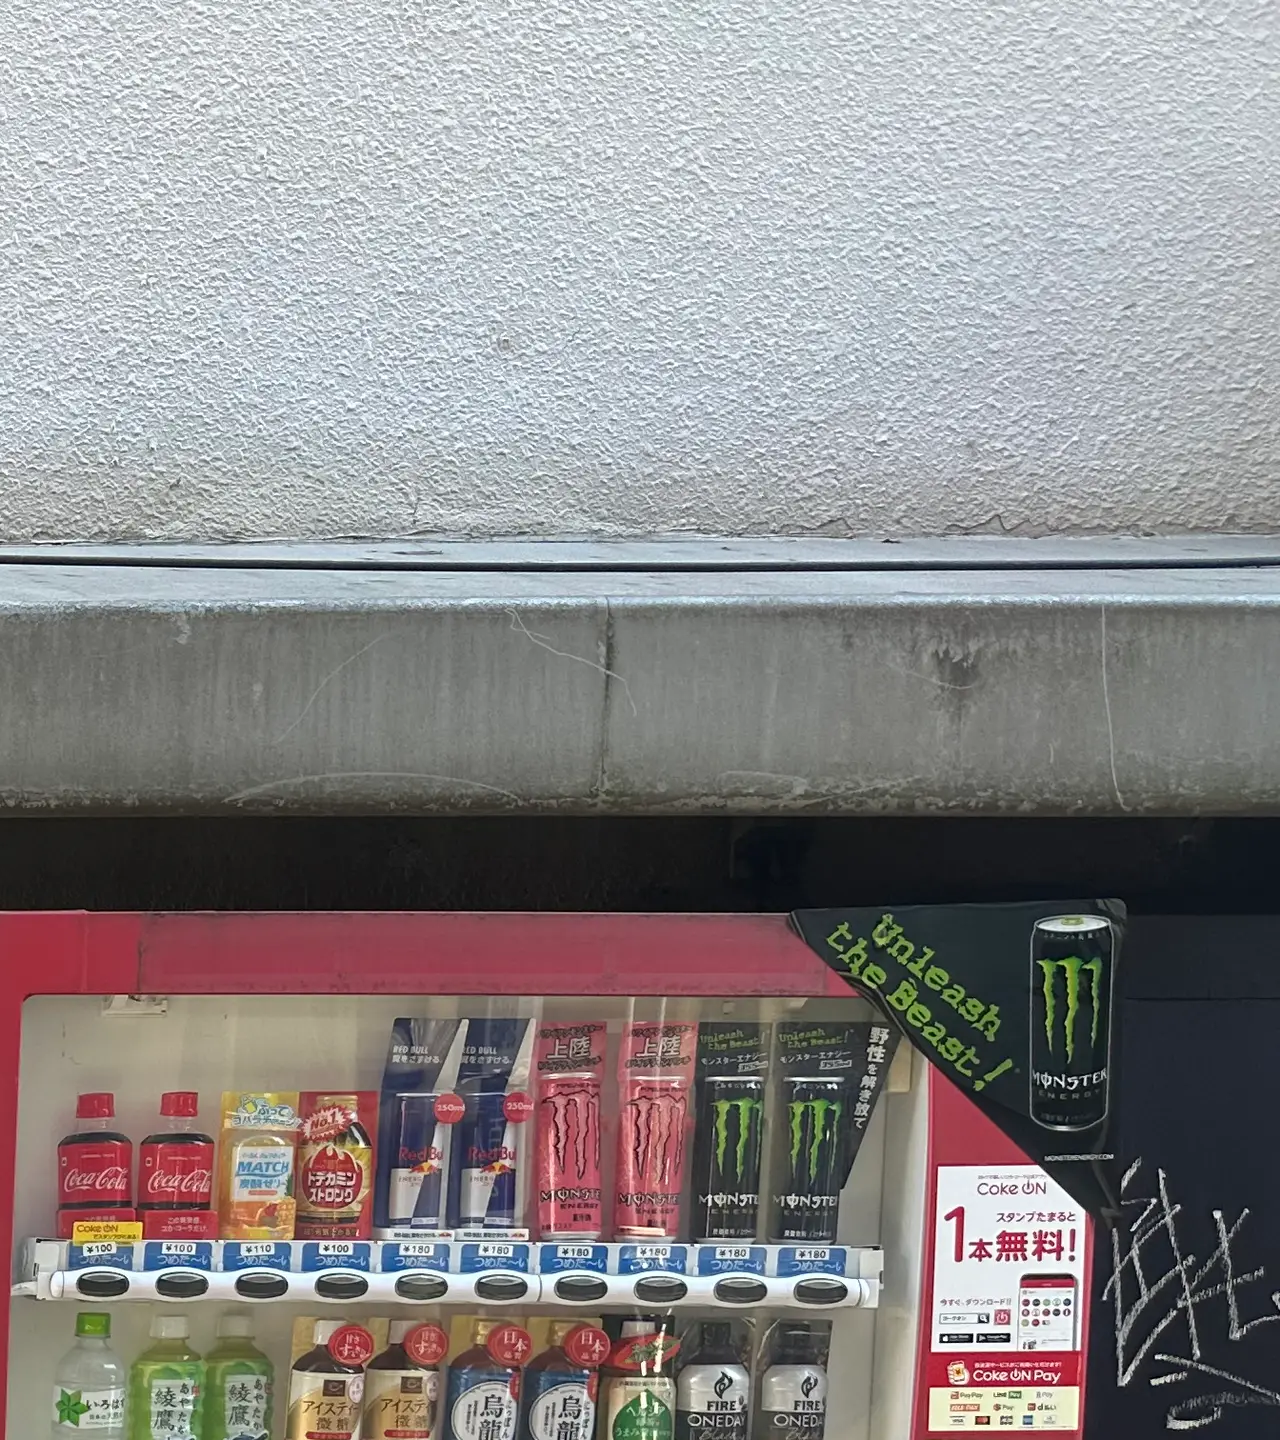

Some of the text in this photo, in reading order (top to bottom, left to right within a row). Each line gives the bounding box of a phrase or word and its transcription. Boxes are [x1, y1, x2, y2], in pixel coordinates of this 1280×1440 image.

[871, 913, 1002, 1042] Unleash
[826, 921, 1014, 1092] the Beast!
[410, 1046, 429, 1055] BULL
[547, 1036, 590, 1059] 上陸
[853, 1026, 890, 1130] 野性を解き放て
[238, 1161, 290, 1173] MATCH
[64, 1166, 129, 1193] Coca-Cola
[148, 1169, 212, 1194] Coca-Cola
[308, 1171, 357, 1187] ドデカミン
[977, 1180, 1047, 1195] Coke ON
[309, 1188, 354, 1203] ストロング
[996, 1212, 1076, 1222] スタンプたまると
[77, 1224, 101, 1233] Coke
[944, 1206, 1076, 1262] 1本無料!
[86, 1243, 112, 1254] ¥100
[166, 1244, 193, 1253] ¥100
[245, 1244, 271, 1254] ¥110
[323, 1244, 349, 1253] ¥100
[403, 1244, 431, 1254] ¥180
[483, 1245, 509, 1255] ¥180
[799, 1250, 826, 1259] ¥180
[973, 1370, 1008, 1382] Coke
[1034, 1370, 1061, 1384] Pay
[154, 1387, 177, 1432] 綾鷹
[227, 1383, 251, 1428] 綾鷹
[253, 1379, 263, 1430] あやたか
[302, 1400, 359, 1415] アイスティー
[707, 1401, 736, 1411] FIRE
[794, 1401, 820, 1411] FIRE
